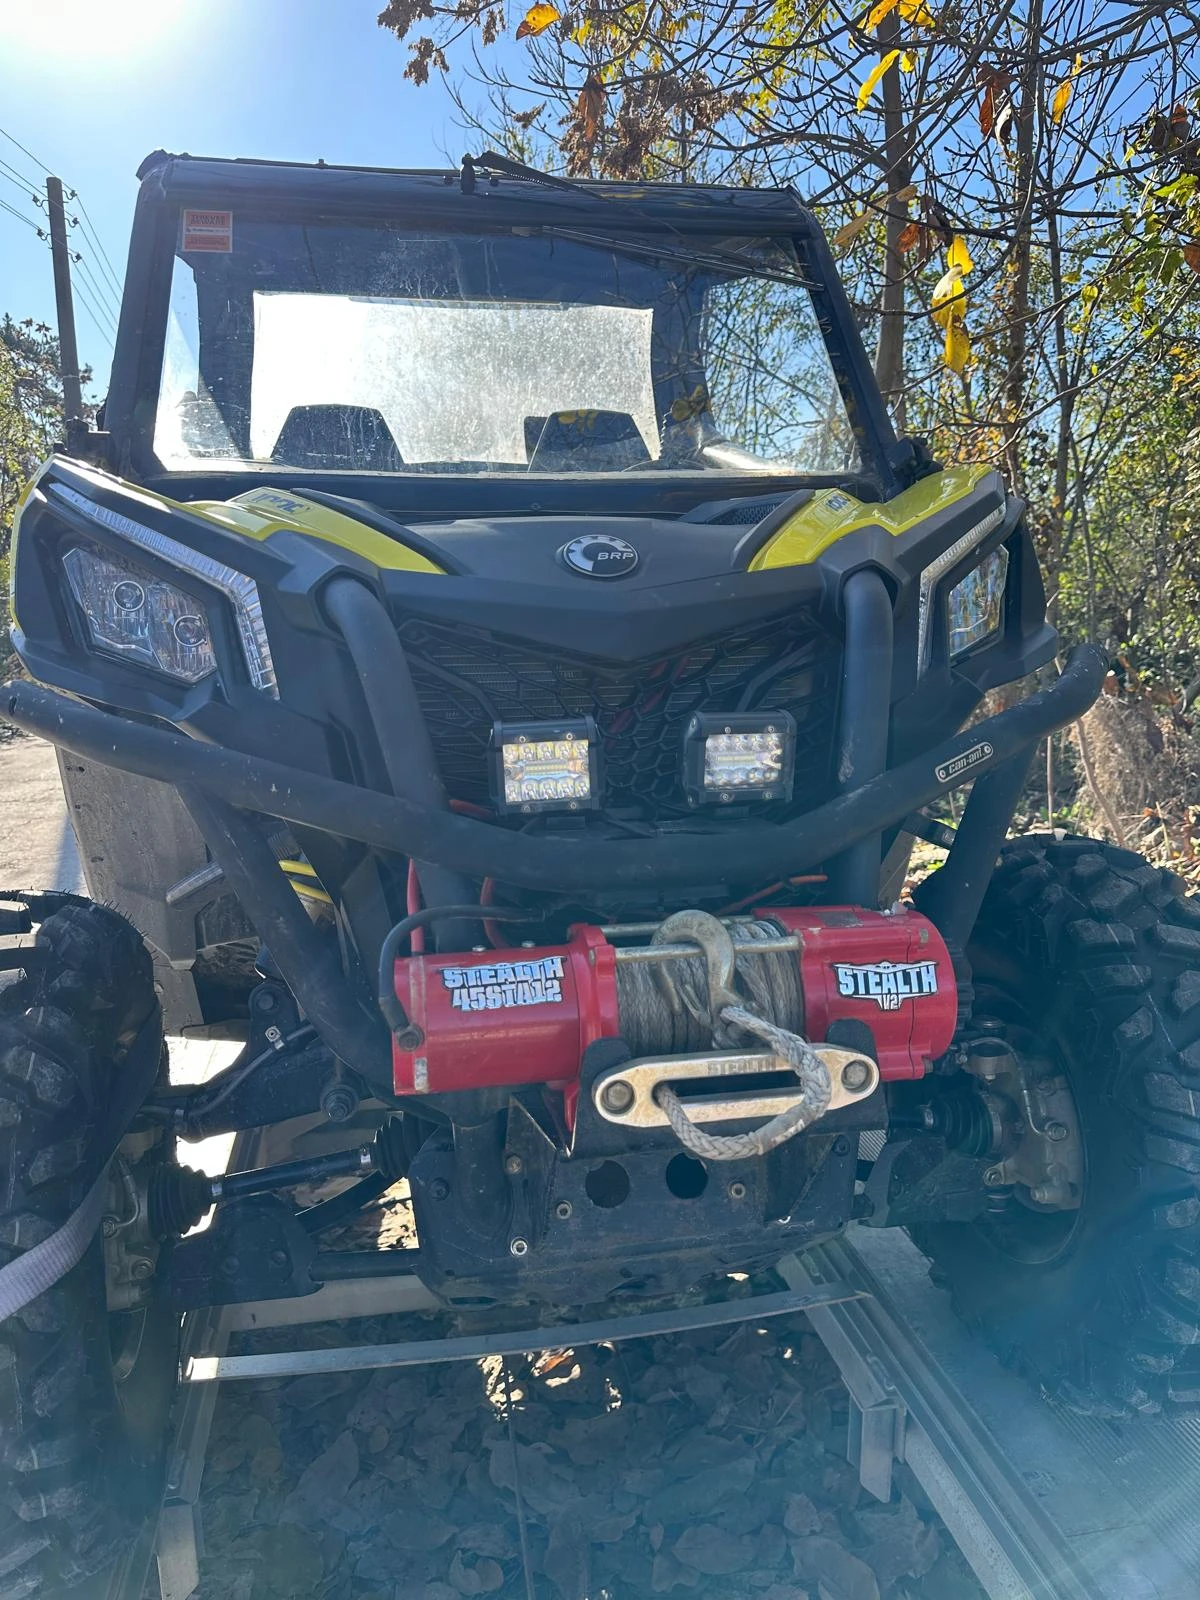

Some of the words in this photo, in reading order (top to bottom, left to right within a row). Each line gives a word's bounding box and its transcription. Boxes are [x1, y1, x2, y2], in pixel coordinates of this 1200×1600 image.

[597, 551, 634, 561] BRP
[443, 957, 565, 988] STEALTH
[837, 965, 938, 995] STEALTH
[882, 994, 899, 1010] V2
